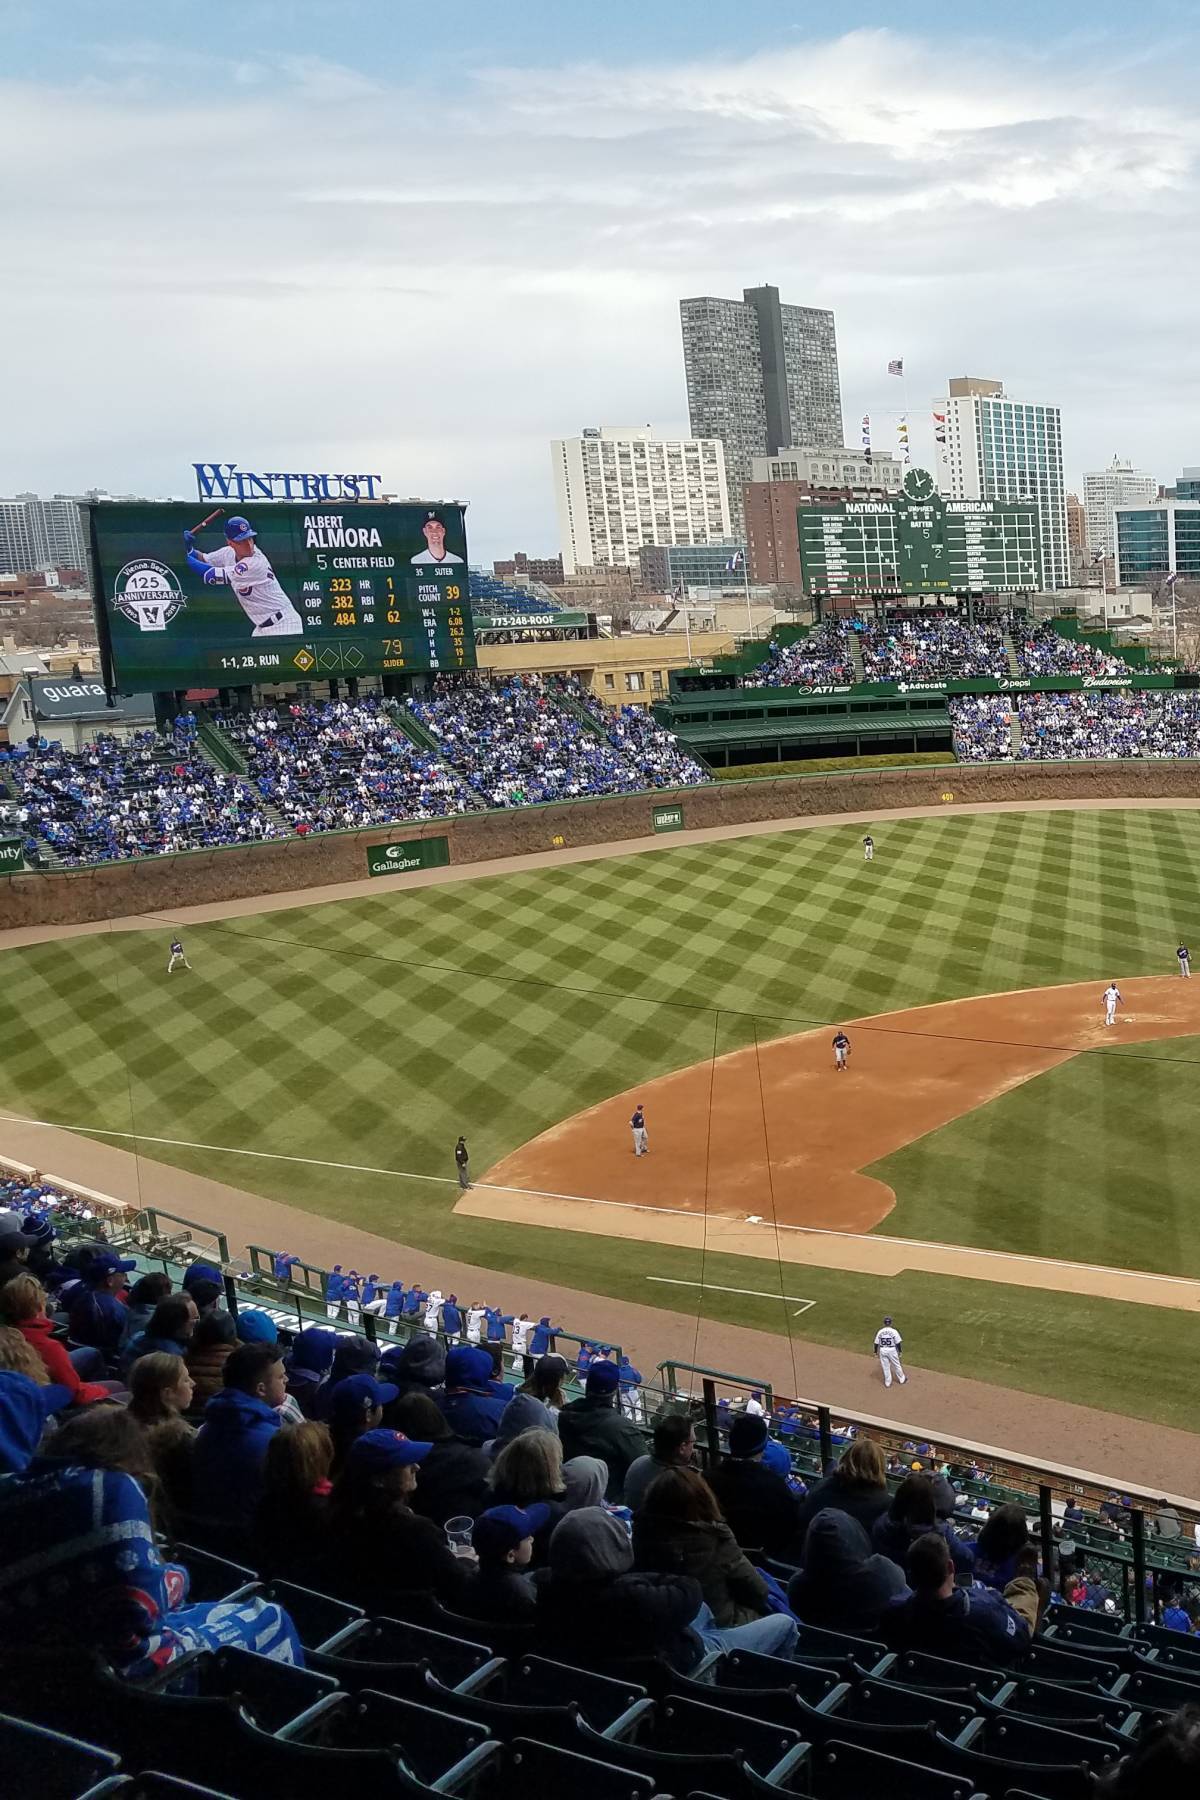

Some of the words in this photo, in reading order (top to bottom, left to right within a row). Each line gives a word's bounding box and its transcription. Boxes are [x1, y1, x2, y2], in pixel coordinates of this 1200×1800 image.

[845, 503, 896, 513] NATIONAL
[945, 502, 994, 513] AMERICAN
[304, 516, 344, 529] ALBERT
[306, 528, 383, 548] ALMORA
[923, 528, 930, 539] 5
[935, 548, 942, 559] 2
[317, 554, 328, 570] 5
[333, 557, 368, 569] CENTER
[371, 556, 395, 568] FIELD
[123, 562, 148, 576] Vienna
[434, 567, 454, 576] SUTER
[131, 577, 160, 589] 125
[303, 581, 320, 591] AVG
[329, 578, 352, 592] .323
[359, 580, 371, 589] HR
[386, 577, 393, 589] 1
[418, 585, 438, 593] PITCH
[445, 585, 460, 600] 39
[117, 591, 180, 602] ANNIVERSARY
[305, 598, 322, 608] OBP
[331, 595, 354, 609] .382
[361, 596, 375, 606] RBI
[388, 594, 395, 606] 7
[418, 593, 441, 602] COUNT
[421, 608, 436, 617] W-L
[307, 615, 322, 626] SLG
[333, 613, 356, 626] .484
[363, 613, 375, 623] AB
[387, 611, 400, 623] 62
[423, 619, 437, 627] ERA
[491, 615, 554, 627] 773-248-ROOF
[427, 629, 435, 638] IP
[382, 639, 402, 656] 79
[429, 639, 435, 647] H
[430, 649, 436, 658] K
[221, 657, 240, 669] 1-1,
[242, 656, 257, 668] 2B,
[259, 654, 280, 666] RUN
[383, 659, 404, 667] SLIDER
[430, 659, 439, 668] BB
[909, 682, 947, 690] Advocate
[1009, 679, 1031, 688] pepsi
[1081, 676, 1132, 687] Budweiser
[42, 684, 106, 702] guara
[812, 686, 833, 694] ATI
[372, 858, 421, 872] Gallagher
